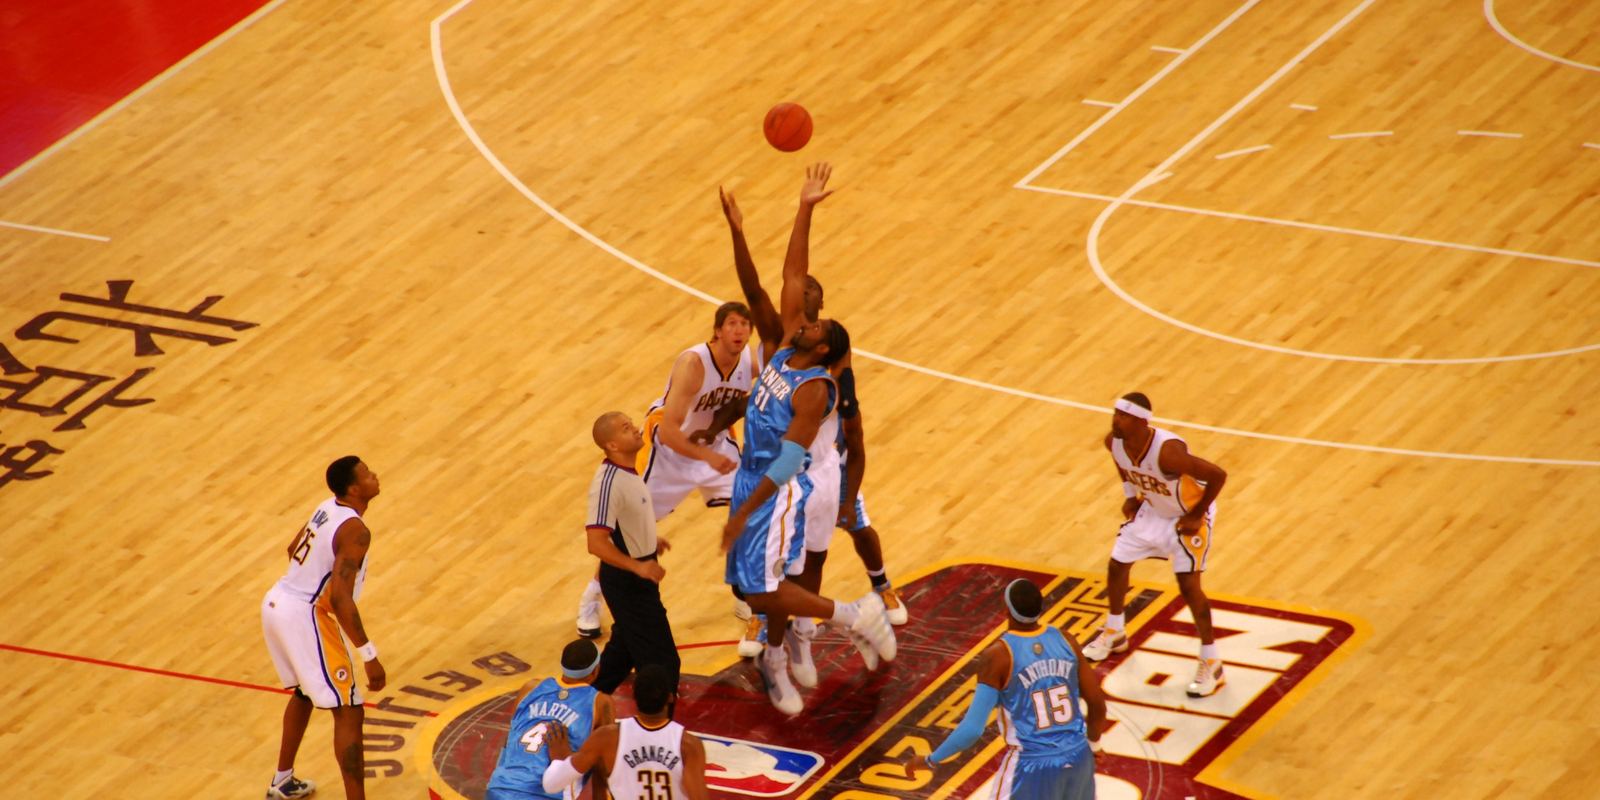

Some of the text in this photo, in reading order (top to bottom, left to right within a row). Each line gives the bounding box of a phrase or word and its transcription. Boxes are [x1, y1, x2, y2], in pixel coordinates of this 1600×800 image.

[693, 387, 747, 412] PACER
[755, 385, 770, 412] 31
[1018, 658, 1073, 690] ANTHONY
[1079, 604, 1334, 766] NBA
[528, 700, 580, 728] MARTIN
[1031, 684, 1074, 730] 15
[519, 721, 548, 753] 4
[623, 745, 680, 771] GRANGER
[637, 769, 673, 800] 33
